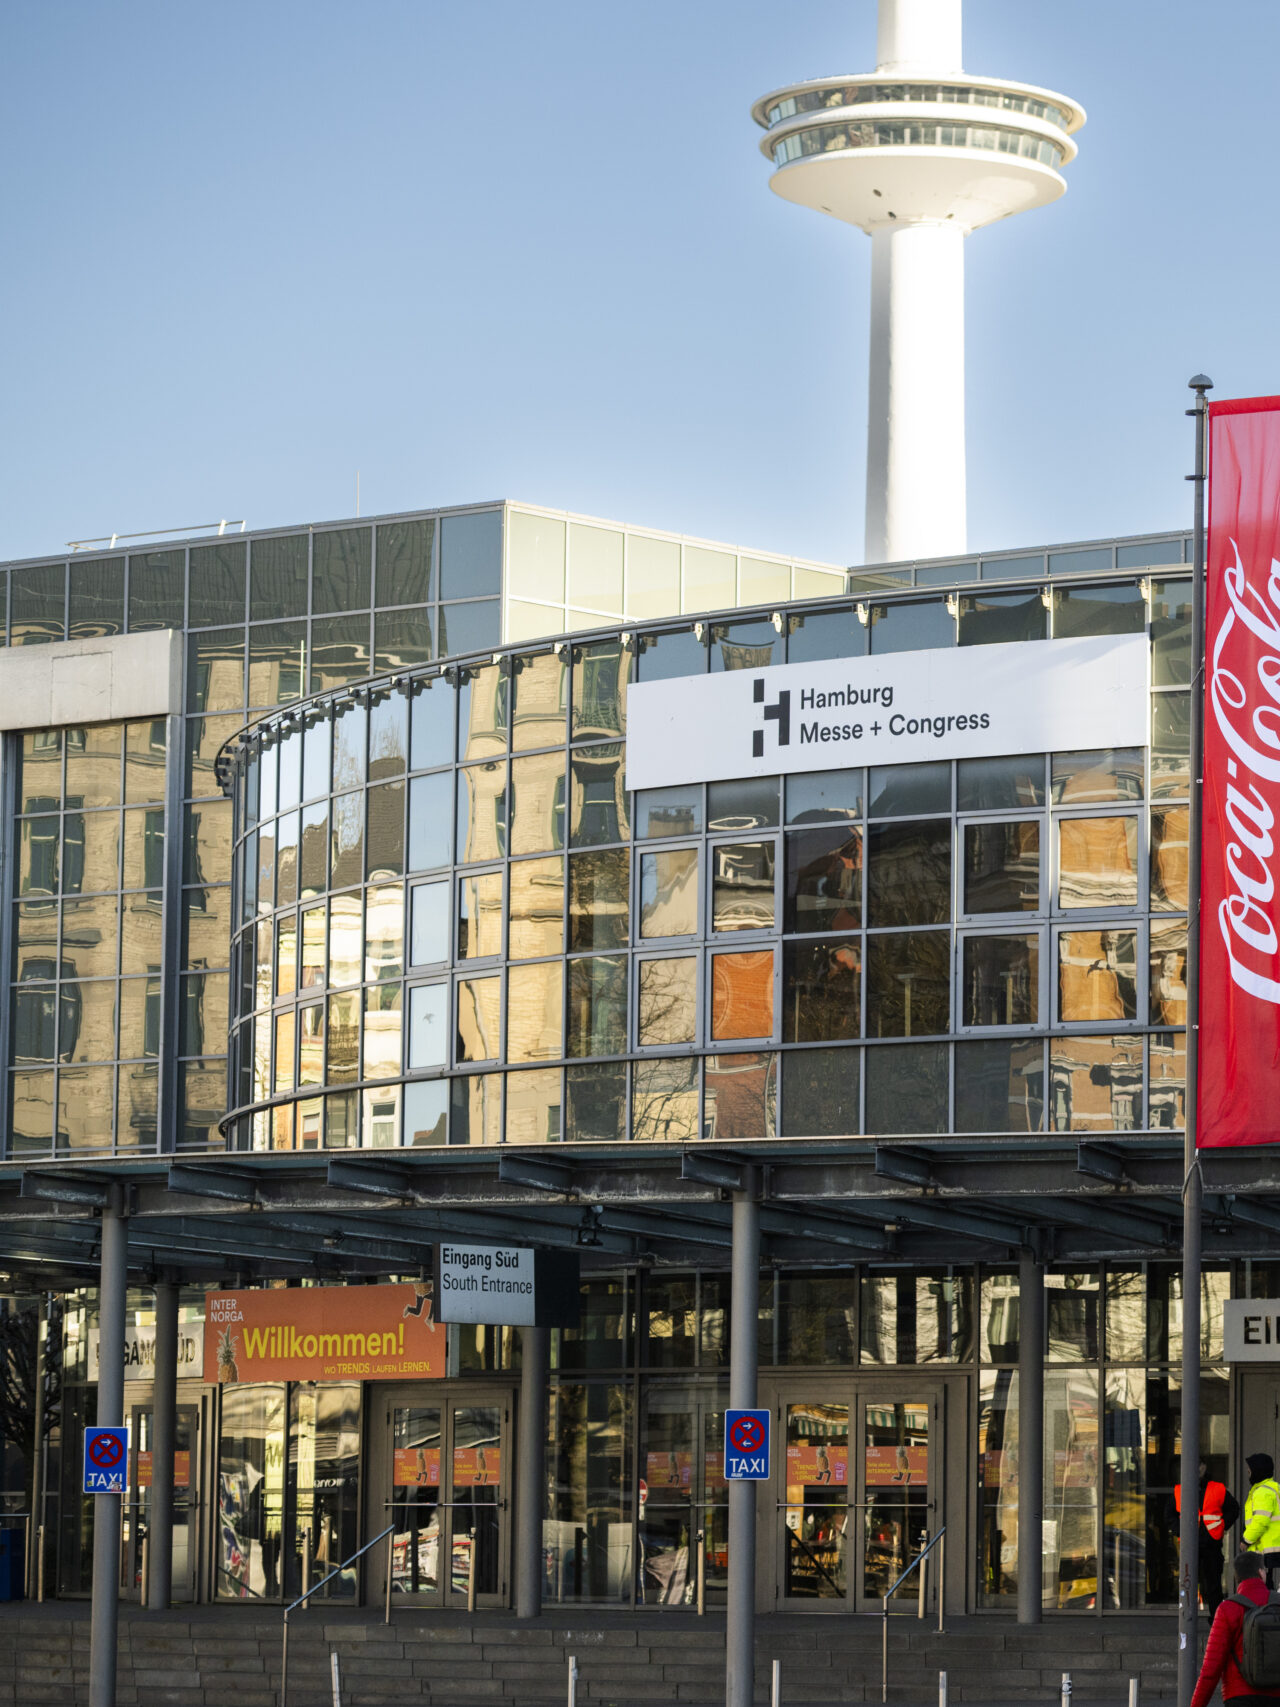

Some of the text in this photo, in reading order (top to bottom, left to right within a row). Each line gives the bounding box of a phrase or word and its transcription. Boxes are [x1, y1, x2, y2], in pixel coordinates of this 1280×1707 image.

[800, 683, 894, 710] Hamburg
[800, 713, 990, 744] Messe + Congress
[442, 1247, 519, 1270] Eingang Süd
[443, 1273, 533, 1294] South Entrance
[211, 1299, 237, 1310] INTER
[210, 1311, 244, 1322] NORGA
[243, 1323, 405, 1360] Willkommen!
[337, 1363, 370, 1374] TRENDS
[372, 1364, 397, 1373] LAUFEN
[730, 1458, 764, 1472] TAXI
[88, 1473, 122, 1488] TAXI
